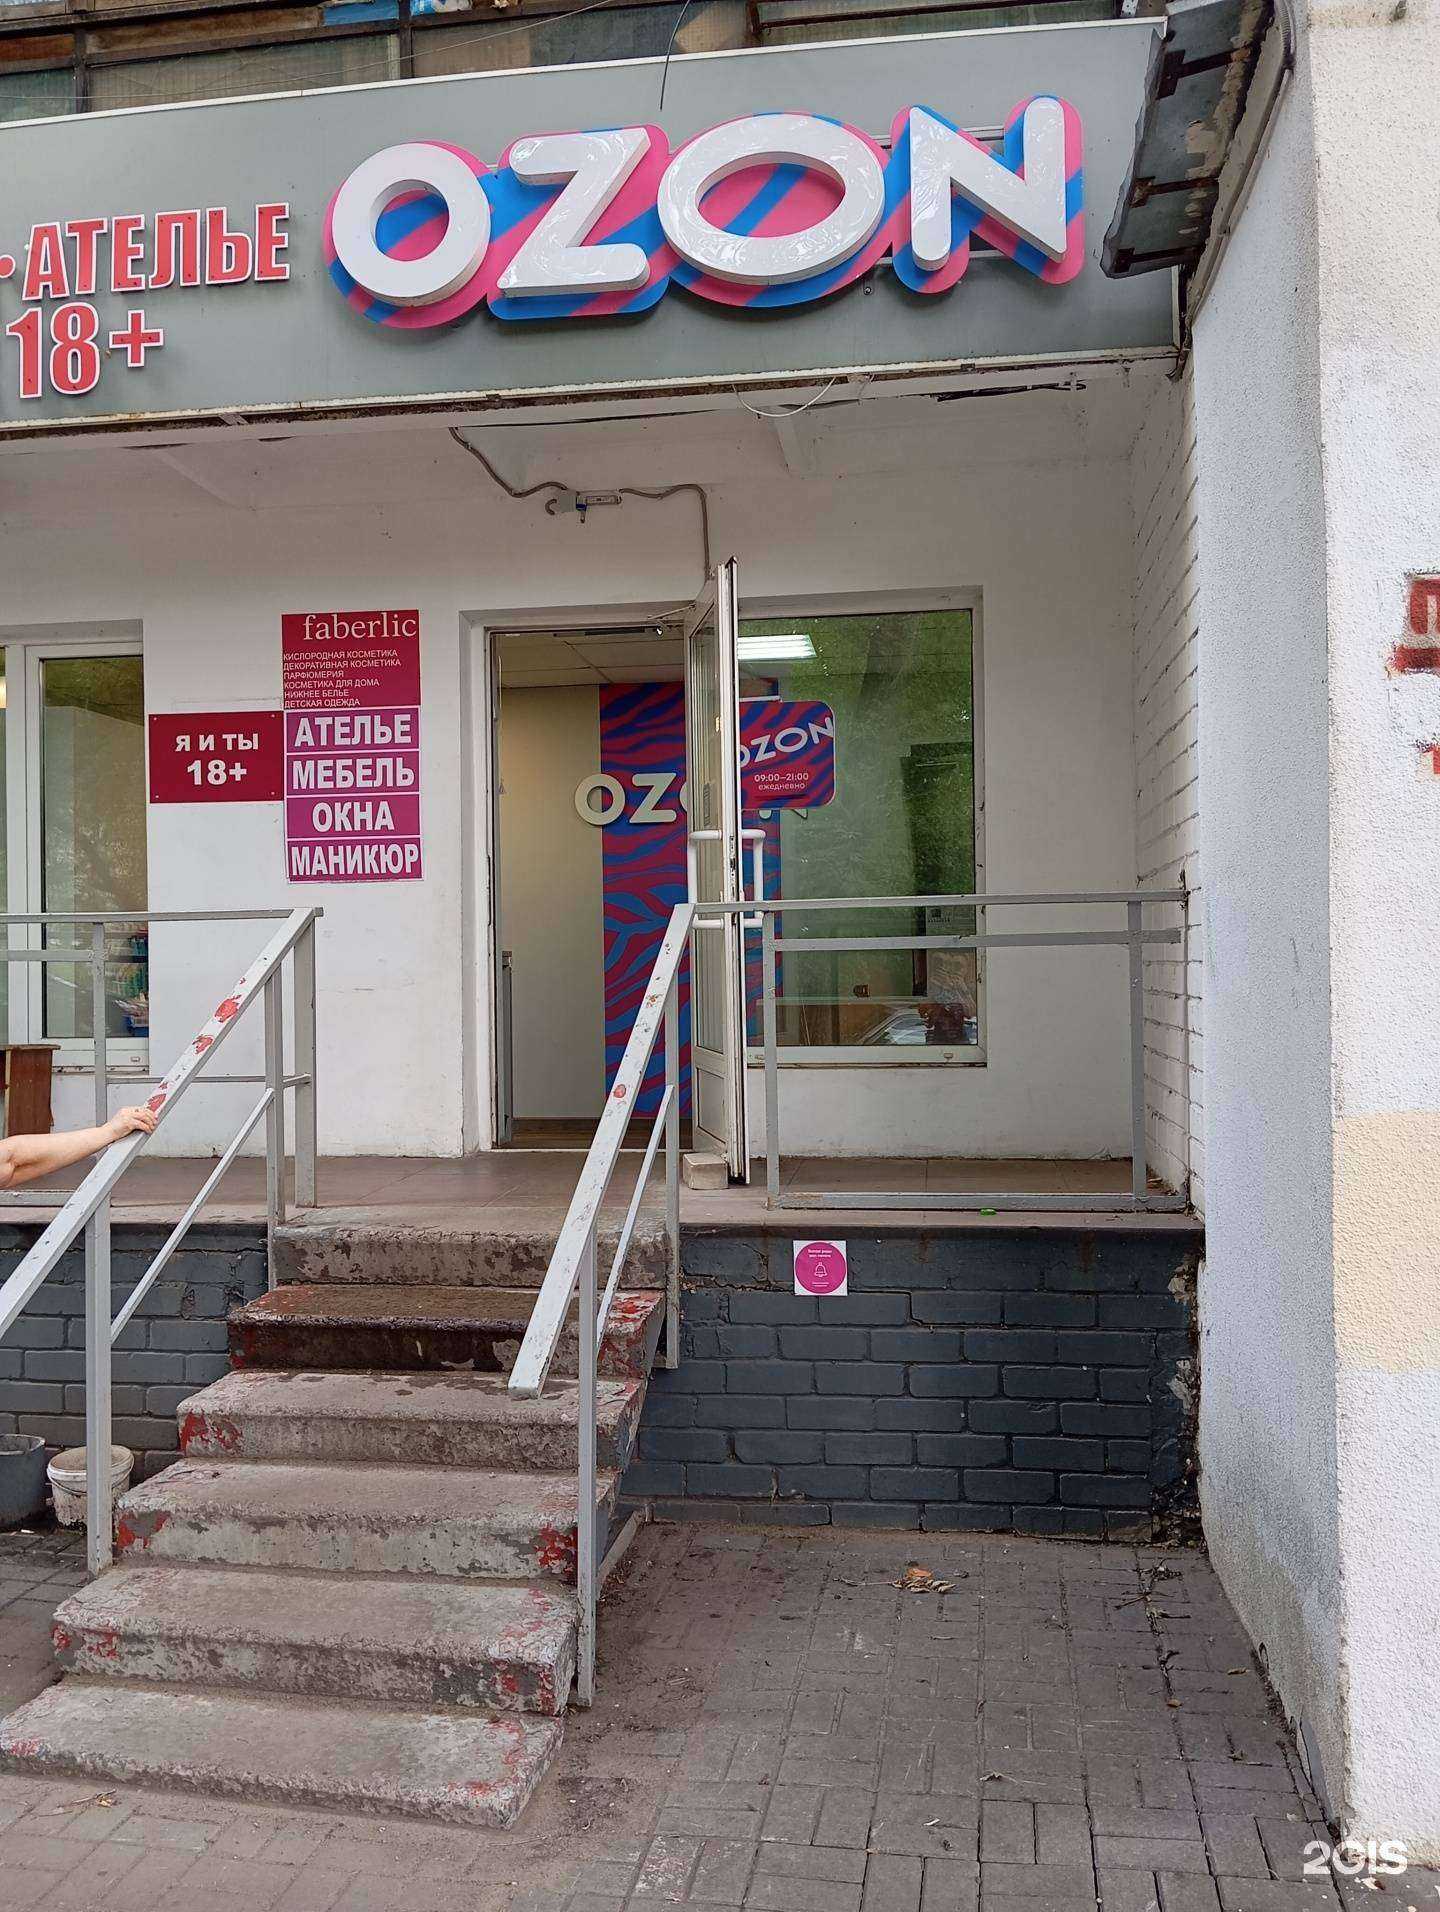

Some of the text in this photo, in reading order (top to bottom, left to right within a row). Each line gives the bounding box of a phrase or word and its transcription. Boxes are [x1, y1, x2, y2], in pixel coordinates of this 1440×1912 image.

[330, 95, 1070, 308] OZON
[22, 203, 290, 300] АТЕЛЬЕ
[6, 302, 164, 398] 18+
[303, 612, 417, 640] faberlic
[283, 649, 398, 661] КИСЛОРОДНАЯ КОСМЕТИКА
[283, 658, 401, 671] ДЕКОРАТИВНАЯ КОСМЕТИКА
[283, 670, 344, 680] ПАРФЮМЕРИЯ
[284, 678, 380, 689] КОСМЕТИКА ДЛЯ ДОМА
[284, 688, 350, 699] НИЖНЕЕ БЕЛЬЕ
[284, 698, 360, 709] ДЕТСКАЯ ОДЕЖДА
[294, 714, 412, 747] АТЕЛЬЕ
[187, 760, 248, 786] 18+
[292, 757, 415, 790] МЕБЕЛЬ
[312, 800, 395, 833] ОКНА
[291, 843, 419, 877] МАНИКЮР
